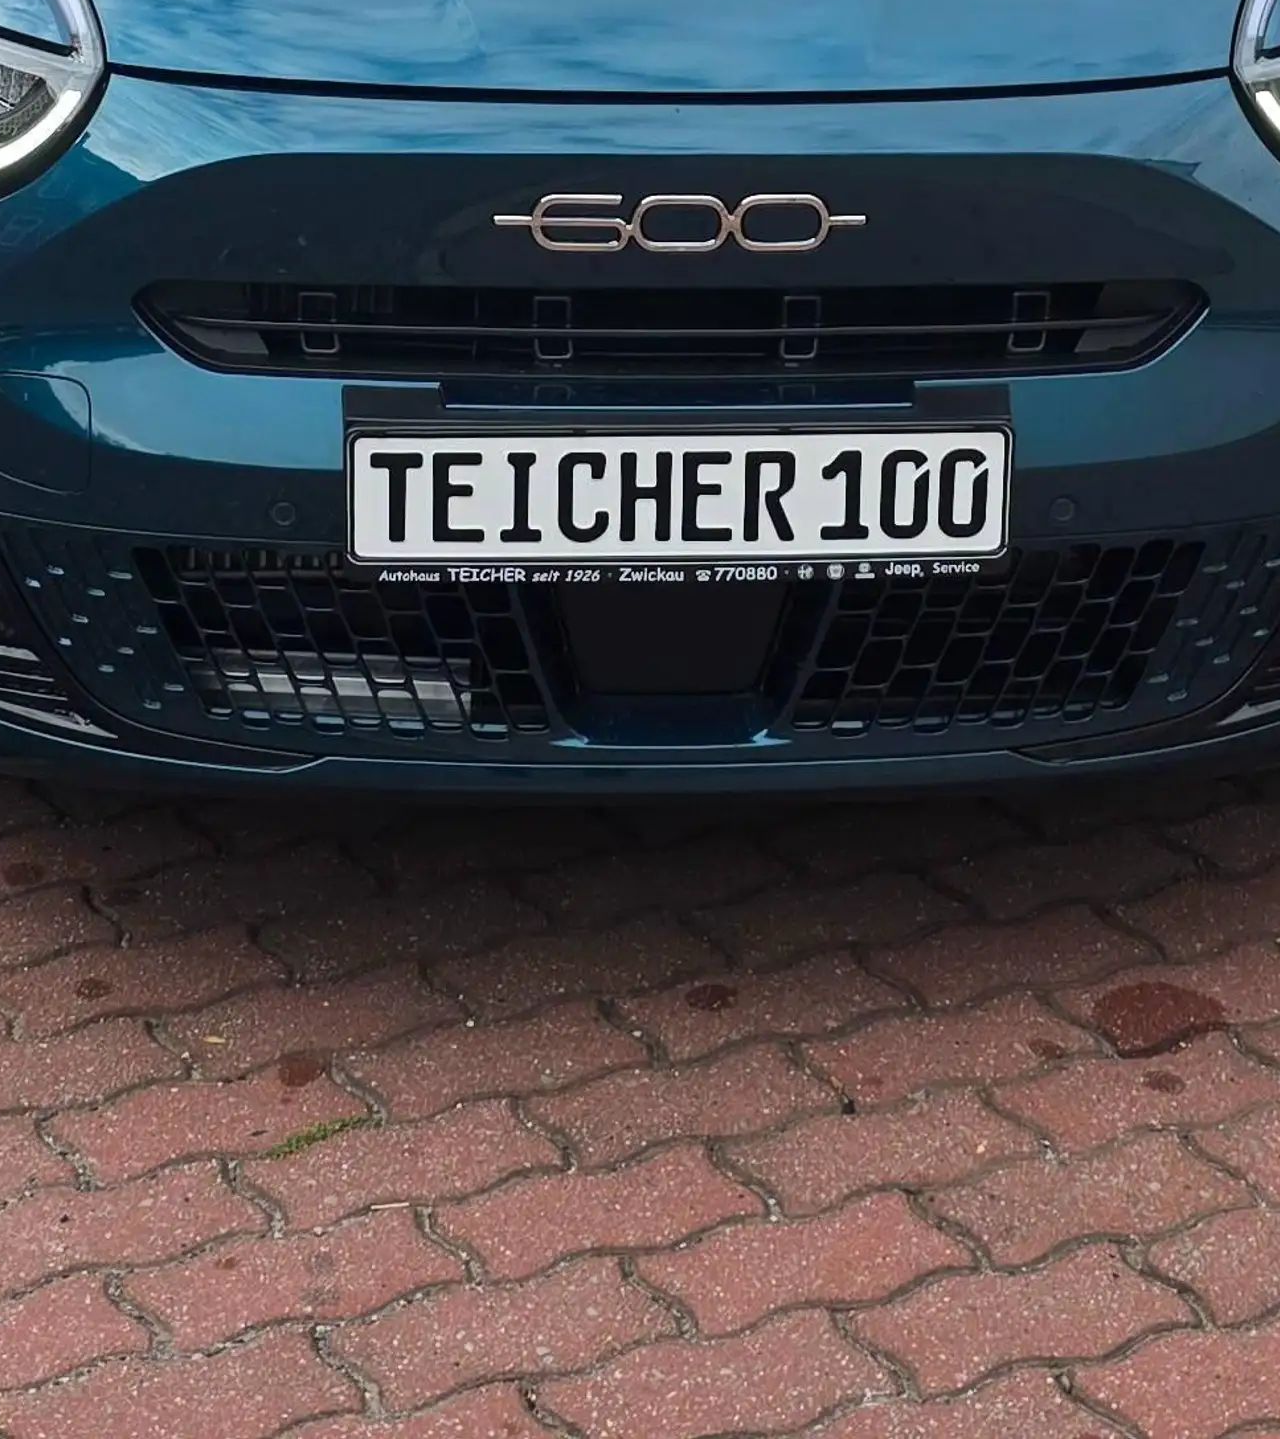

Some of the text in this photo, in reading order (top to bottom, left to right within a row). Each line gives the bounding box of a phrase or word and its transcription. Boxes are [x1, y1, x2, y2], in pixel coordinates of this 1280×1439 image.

[529, 193, 833, 252] 600
[369, 448, 989, 544] TEICHER 100
[378, 569, 440, 582] Autohaus
[447, 567, 527, 583] TEICHER
[531, 569, 560, 582] seit
[564, 569, 601, 583] 1926
[618, 566, 685, 582] Zwickau
[932, 560, 980, 574] Service
